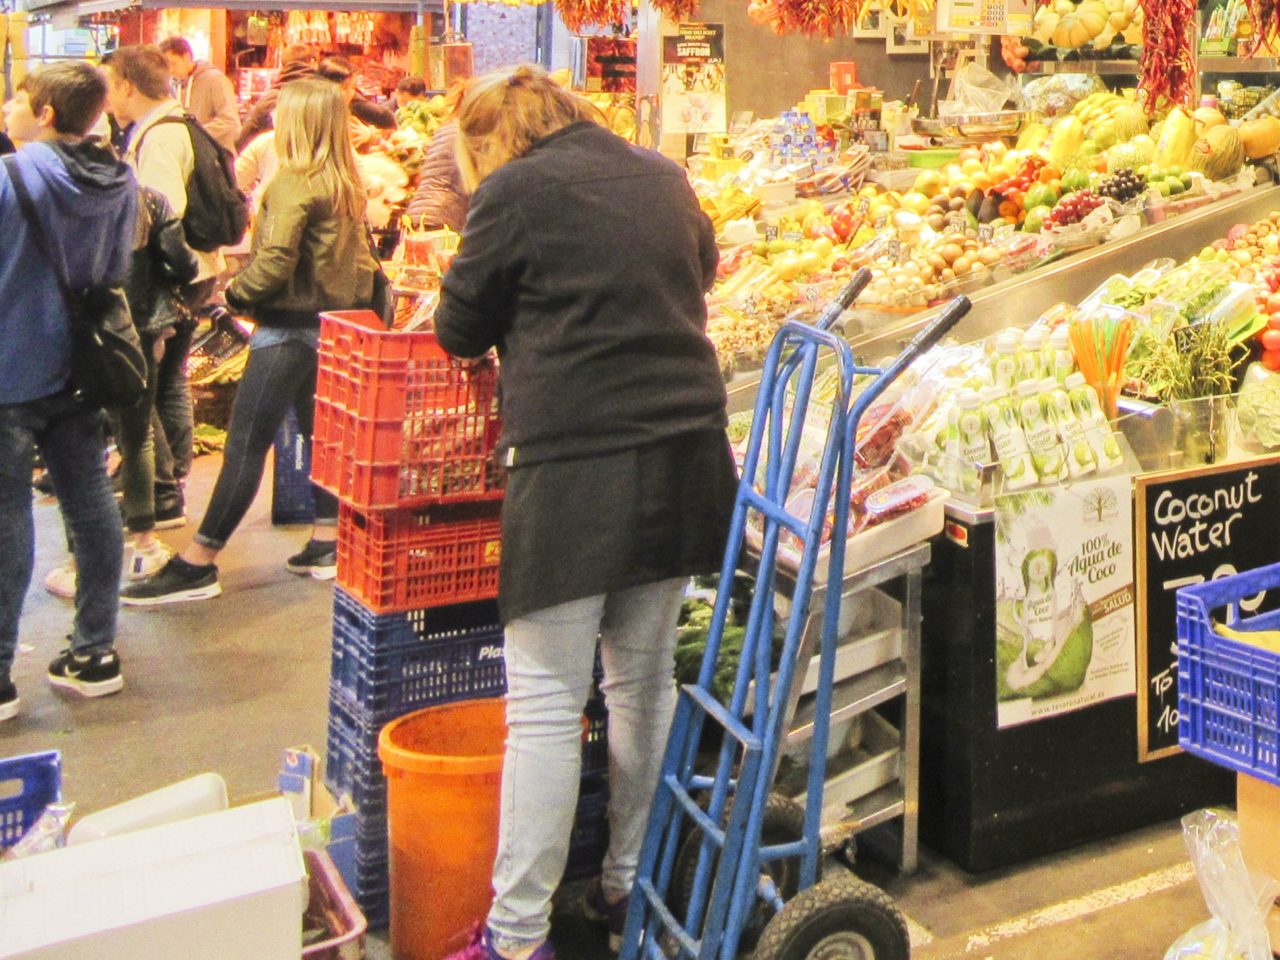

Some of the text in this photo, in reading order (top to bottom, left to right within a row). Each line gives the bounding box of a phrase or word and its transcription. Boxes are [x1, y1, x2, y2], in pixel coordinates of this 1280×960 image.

[676, 47, 710, 57] SAFFRON
[1154, 471, 1262, 525] Coconut
[1081, 532, 1110, 556] 100%
[1152, 512, 1242, 562] Water
[1067, 540, 1122, 577] Agua de
[1087, 564, 1116, 584] Coco
[1103, 592, 1132, 614] SALUD
[1030, 691, 1105, 717] www.tesoronatural.es
